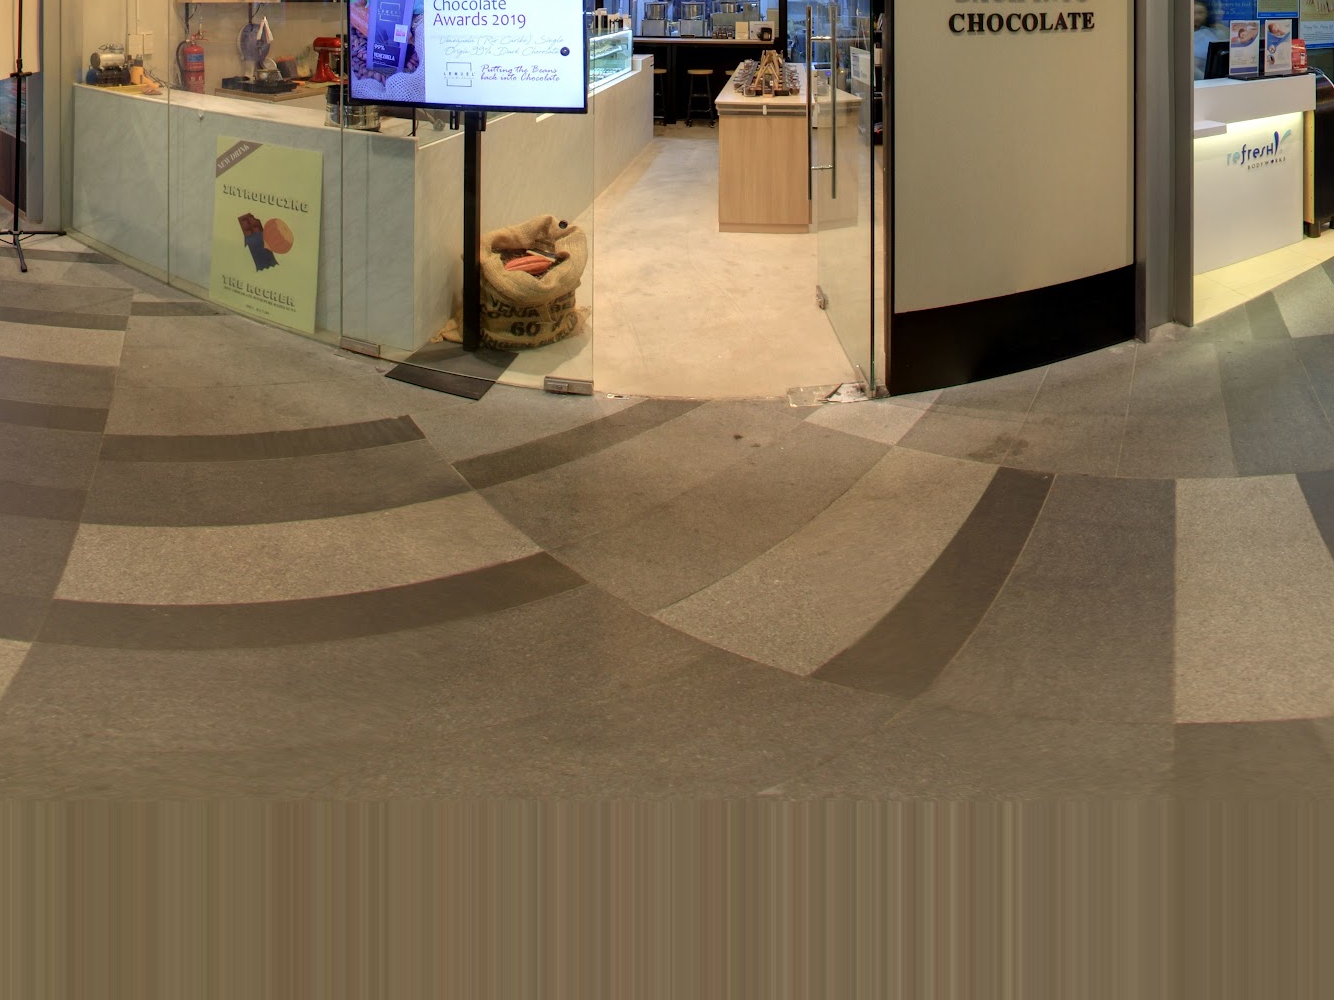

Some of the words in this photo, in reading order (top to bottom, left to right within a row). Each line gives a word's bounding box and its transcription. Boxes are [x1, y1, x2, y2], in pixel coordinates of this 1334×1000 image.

[432, 12, 488, 26] Awards
[492, 14, 526, 28] 2019
[948, 11, 1095, 33] CHOCOLATE
[445, 47, 469, 58] Origin
[493, 47, 519, 56] Dark
[522, 46, 559, 56] Chocolate
[481, 64, 513, 74] Putting
[514, 65, 528, 73] the
[531, 65, 558, 73] Beans
[500, 73, 517, 81] into
[521, 73, 560, 81] Chocolate
[217, 158, 231, 170] NEW
[230, 143, 250, 163] DRINK
[223, 184, 309, 213] INTRODUCING
[222, 274, 244, 290] THE
[510, 321, 541, 336] 60
